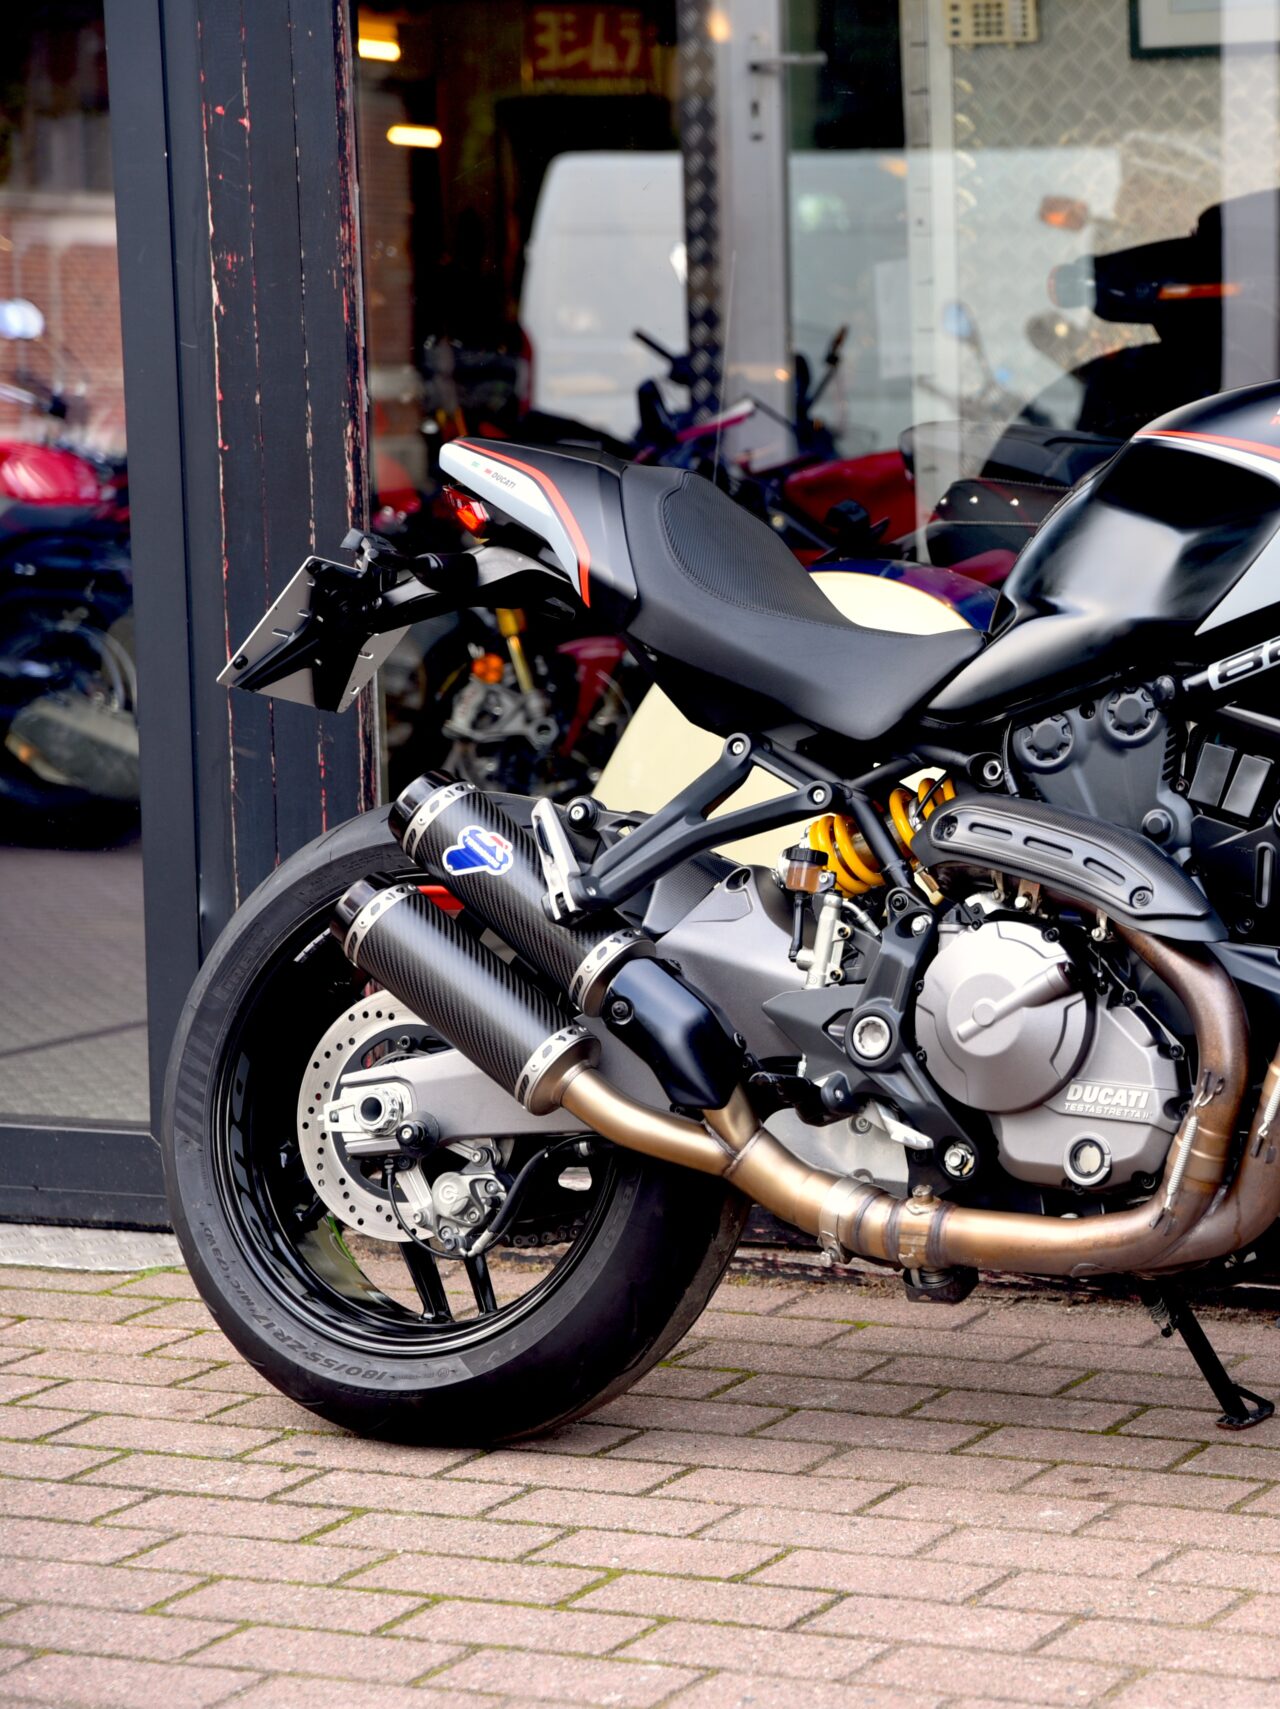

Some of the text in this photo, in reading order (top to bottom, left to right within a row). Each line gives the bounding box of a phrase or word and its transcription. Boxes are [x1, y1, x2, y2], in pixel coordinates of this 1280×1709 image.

[491, 471, 517, 489] DUCATI
[1066, 1084, 1150, 1109] DUCATI
[1064, 1102, 1141, 1119] TESTASTRETTA
